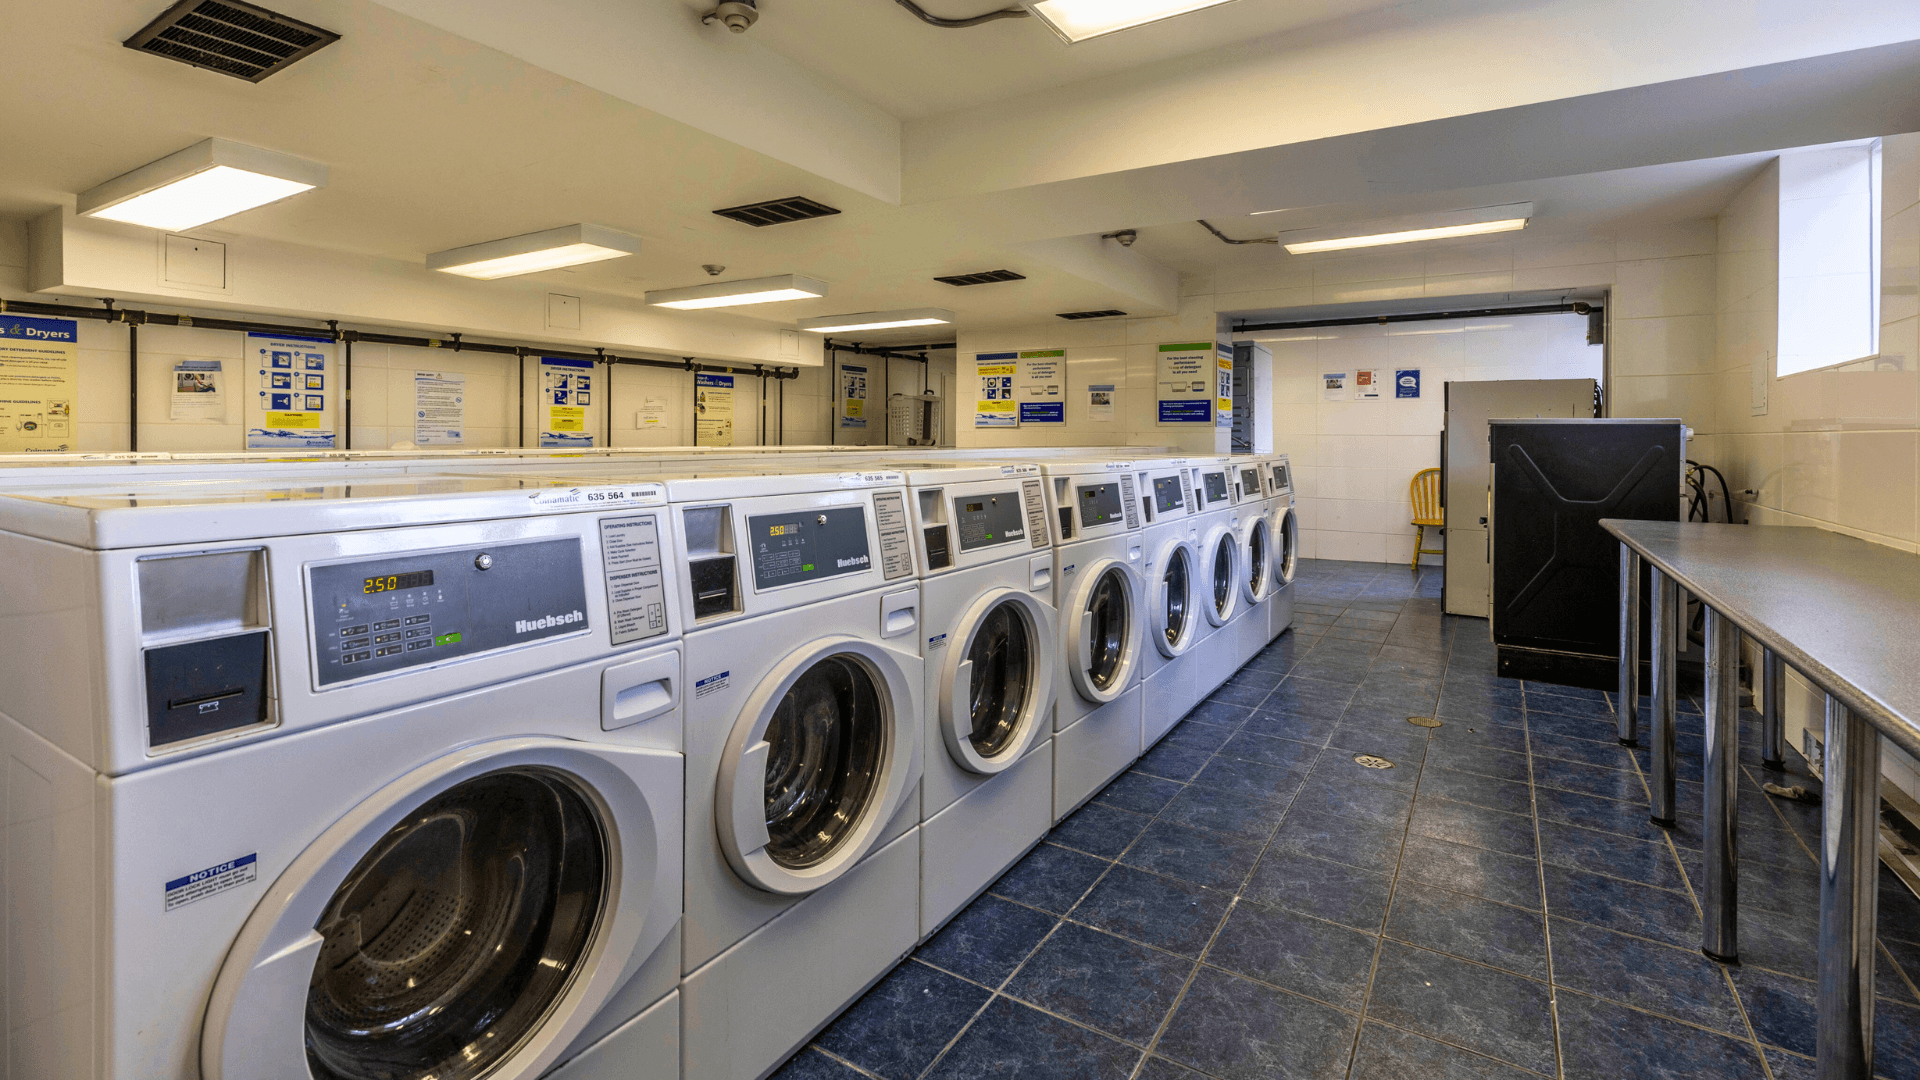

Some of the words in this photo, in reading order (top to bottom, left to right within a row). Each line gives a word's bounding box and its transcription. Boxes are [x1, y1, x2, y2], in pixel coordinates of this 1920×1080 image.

[26, 327, 70, 339] Dryers
[533, 495, 580, 504] Coinamatic
[588, 492, 605, 501] 635
[608, 492, 624, 500] 564
[1005, 528, 1023, 537] Huebsch
[837, 555, 868, 568] Huebsch
[364, 576, 397, 594] 2.50
[515, 610, 583, 634] Huebsch
[190, 861, 236, 882] NOTICE
[168, 888, 184, 897] DOOR
[185, 883, 200, 892] LOCK
[202, 877, 218, 886] LIGHT
[185, 885, 212, 896] attempting
